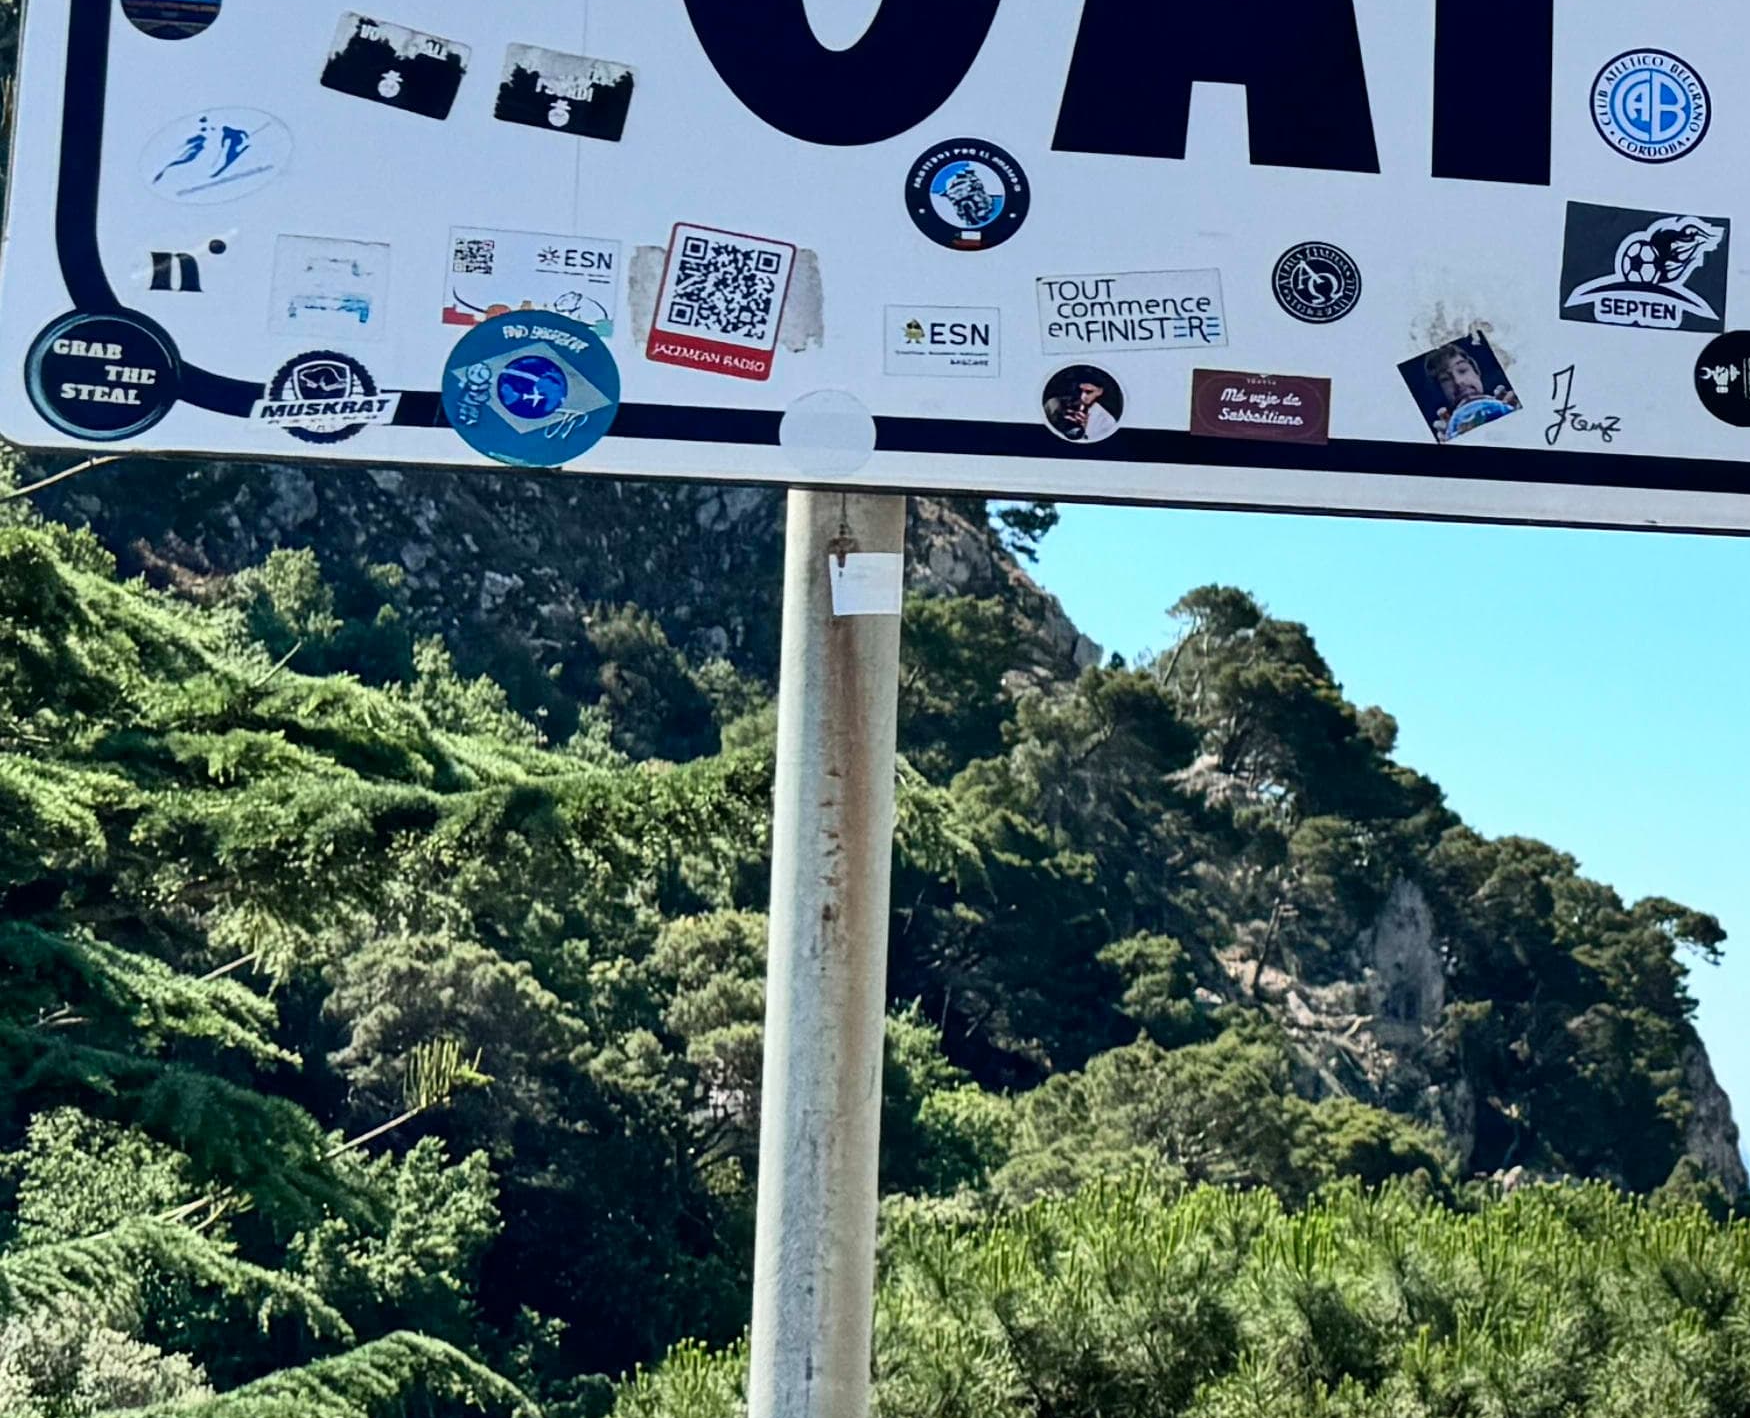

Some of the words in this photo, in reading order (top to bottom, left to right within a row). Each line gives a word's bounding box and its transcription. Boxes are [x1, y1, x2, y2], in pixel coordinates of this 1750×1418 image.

[564, 250, 613, 270] ESN
[1042, 279, 1116, 301] TOUT
[1057, 296, 1211, 319] commence
[1600, 297, 1677, 321] SEPTEN
[930, 322, 989, 346] ESN
[53, 339, 122, 360] GRAB
[105, 365, 156, 384] THE
[60, 383, 141, 405] STEAL
[260, 399, 391, 418] MUSKRAT
